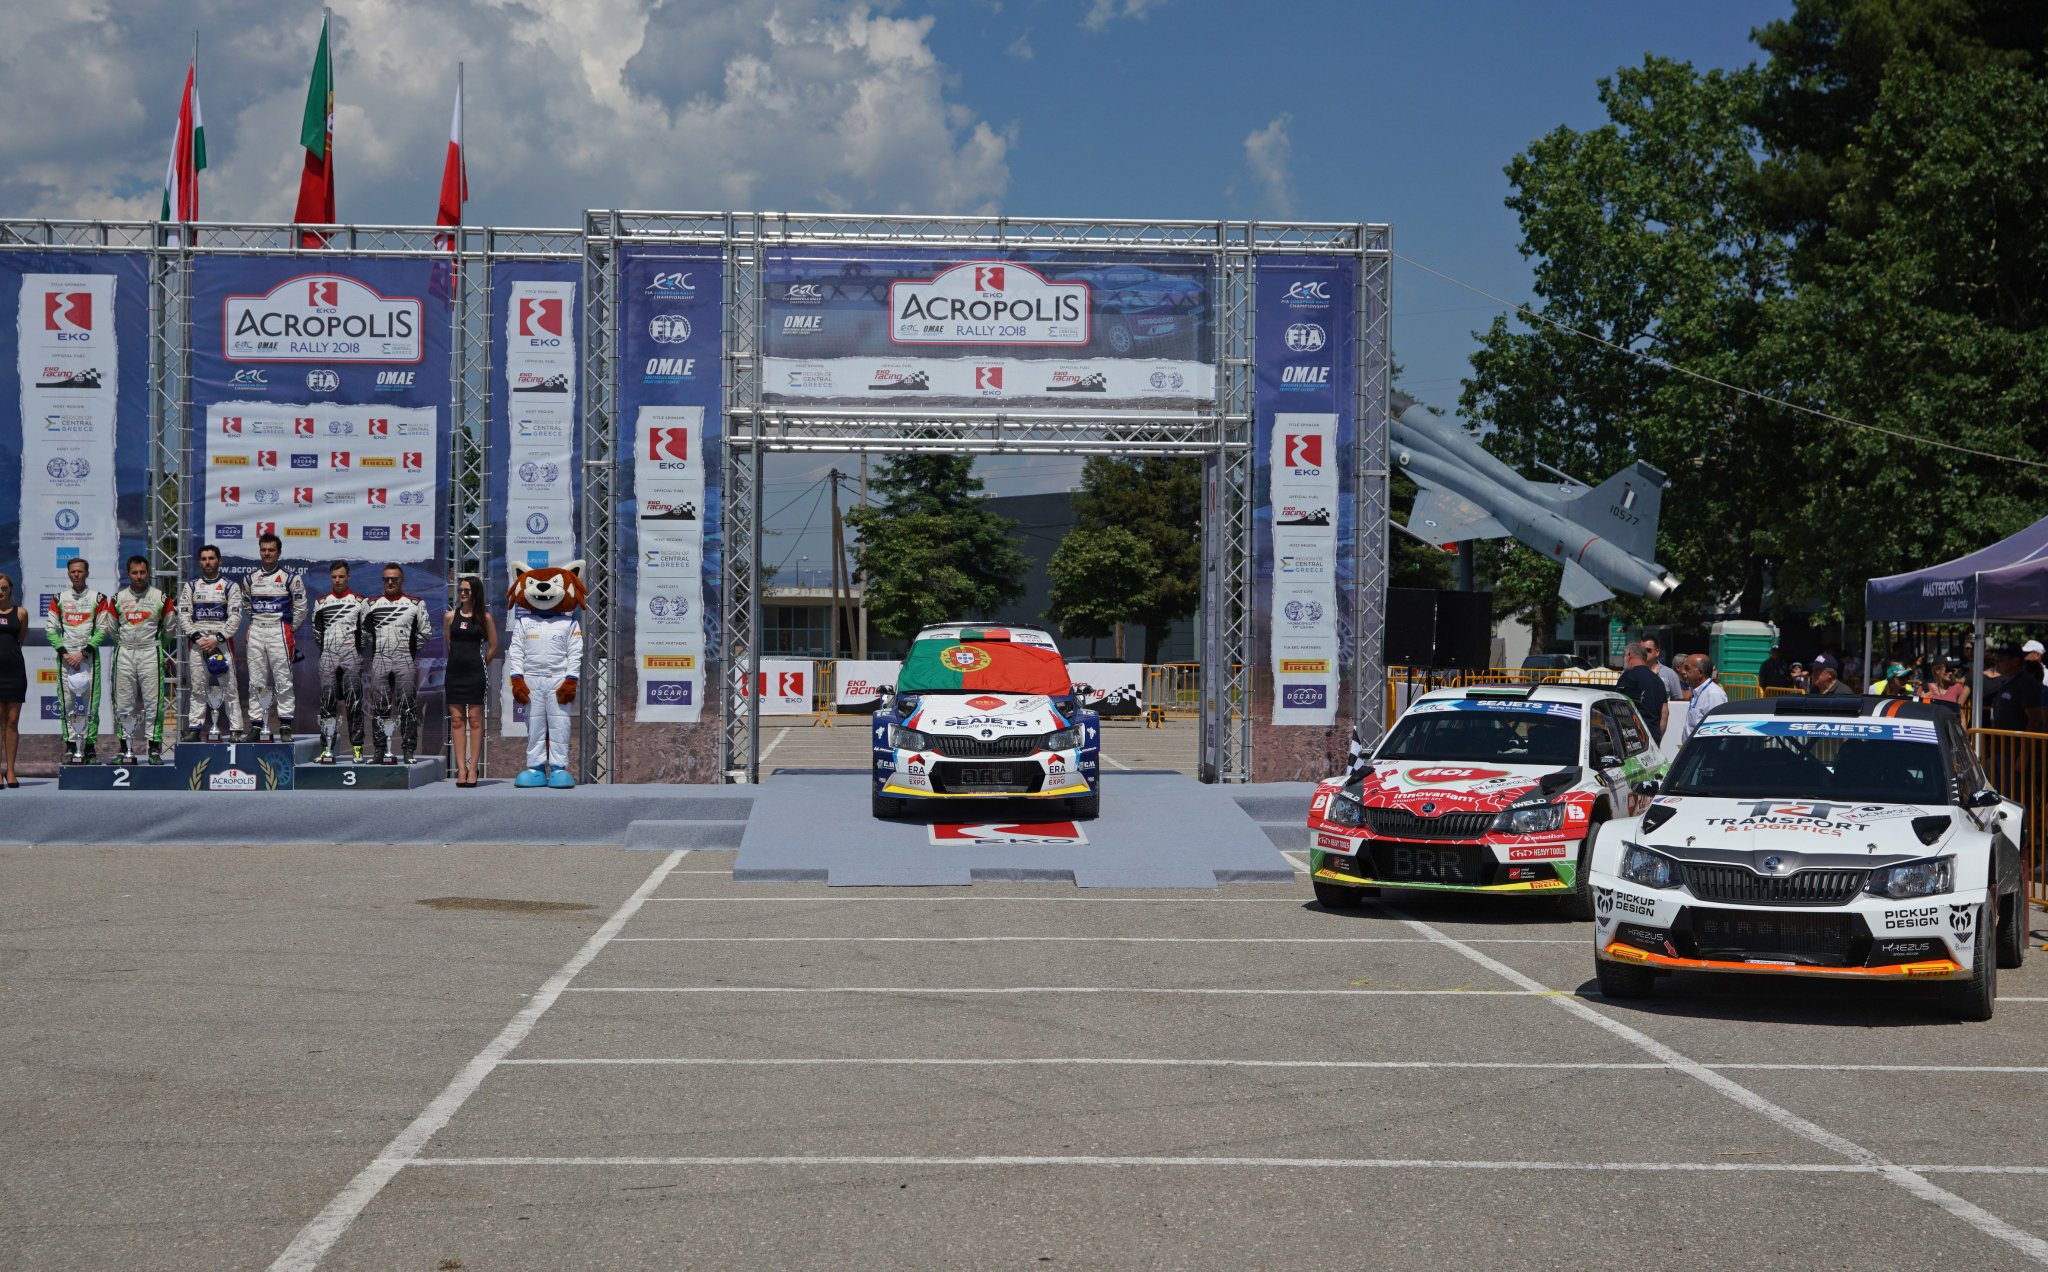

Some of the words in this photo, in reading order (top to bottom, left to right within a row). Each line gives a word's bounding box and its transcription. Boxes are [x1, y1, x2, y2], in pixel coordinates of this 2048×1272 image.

[900, 294, 1079, 322] ACROPOLIS
[235, 309, 412, 338] ACROPOLIS
[784, 316, 822, 328] OMAE
[923, 325, 944, 333] OMAE
[956, 325, 995, 336] RALLY
[1000, 325, 1026, 336] 2018
[257, 341, 278, 349] OMAE
[290, 342, 329, 353] RALLY
[332, 342, 360, 353] 2018
[646, 358, 695, 375] OMAE
[376, 371, 416, 384] OMAE
[874, 373, 903, 381] racing
[1052, 375, 1080, 383] racing
[1282, 366, 1330, 383] OMAE
[1610, 504, 1640, 526] 10577
[1923, 580, 1964, 596] MASTERTENT
[648, 657, 690, 666] PIRELLI
[1284, 662, 1325, 670] PIRELLI
[1477, 700, 1542, 708] SEAJETS
[945, 717, 1028, 727] SEAJETS
[1788, 723, 1883, 733] SEAJETS
[227, 744, 236, 764] 1
[908, 765, 924, 774] ERA
[1049, 765, 1065, 773] ERA
[1415, 768, 1475, 777] MOL
[113, 768, 130, 787] 2
[342, 771, 357, 786] 3
[1511, 798, 1546, 809] iWELD
[1705, 816, 1871, 832] TRANSPORT
[1724, 825, 1738, 833] &
[1743, 823, 1842, 838] LOGISTICS
[1331, 839, 1339, 847] HEAVY
[1394, 848, 1463, 878] BRR
[1530, 879, 1560, 889] PIRELLI
[1616, 892, 1655, 906] PICKUP
[1616, 901, 1654, 917] DESIGN
[1885, 907, 1938, 919] PICKUP
[1886, 917, 1939, 929] DESIGN
[1908, 967, 1950, 977] PIRELLI
